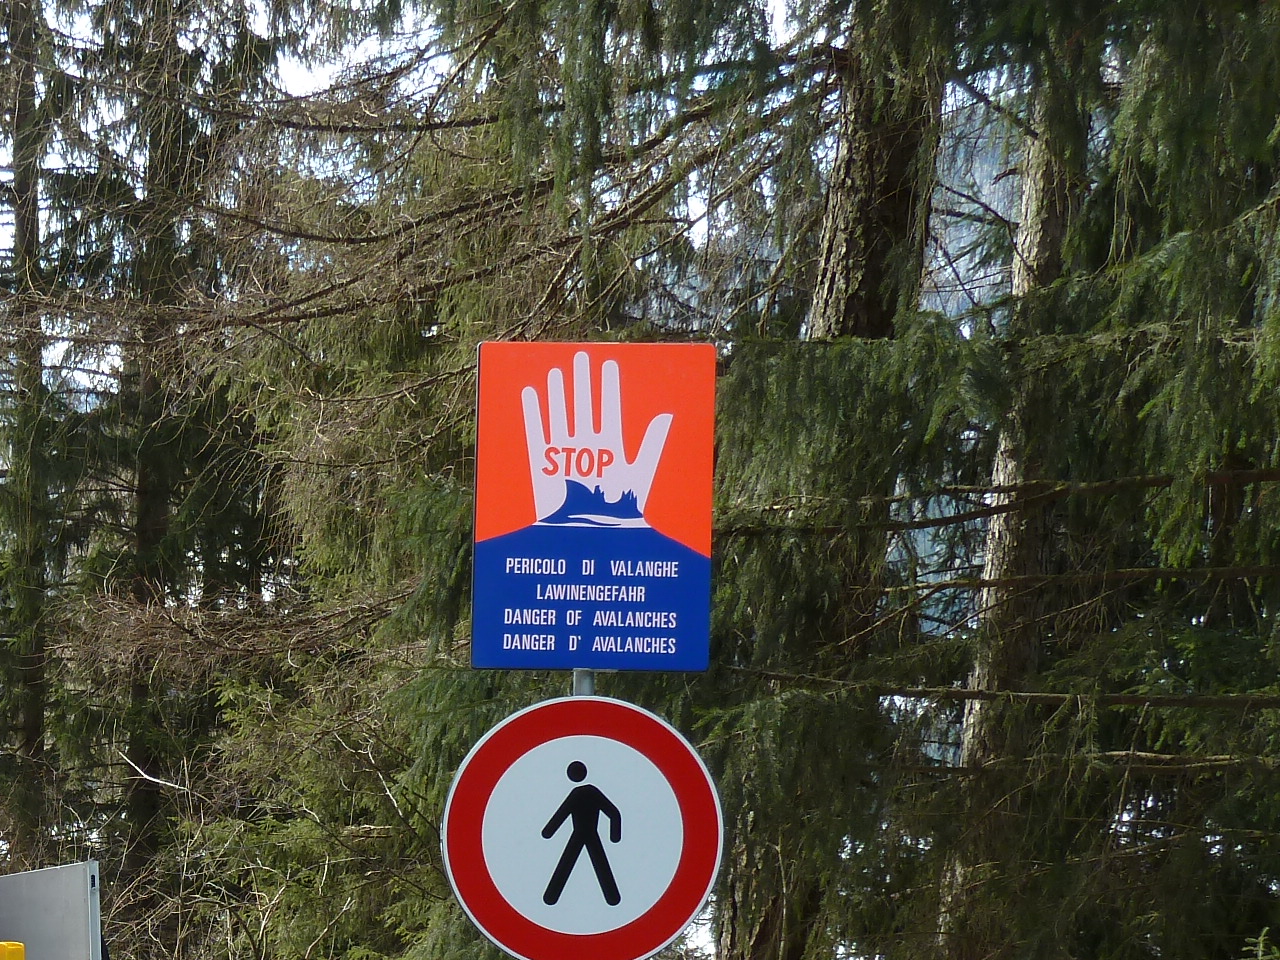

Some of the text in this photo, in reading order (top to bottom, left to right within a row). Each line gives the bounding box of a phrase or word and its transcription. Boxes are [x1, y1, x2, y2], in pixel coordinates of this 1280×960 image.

[542, 446, 615, 478] STOP
[506, 558, 679, 578] PERICOLO DI VALANGHE
[536, 584, 646, 602] LAWINENGEFAHR
[504, 608, 677, 629] DANGER OF AVALANCHES
[503, 633, 555, 651] DANGER
[592, 635, 677, 654] AVALANCHES
